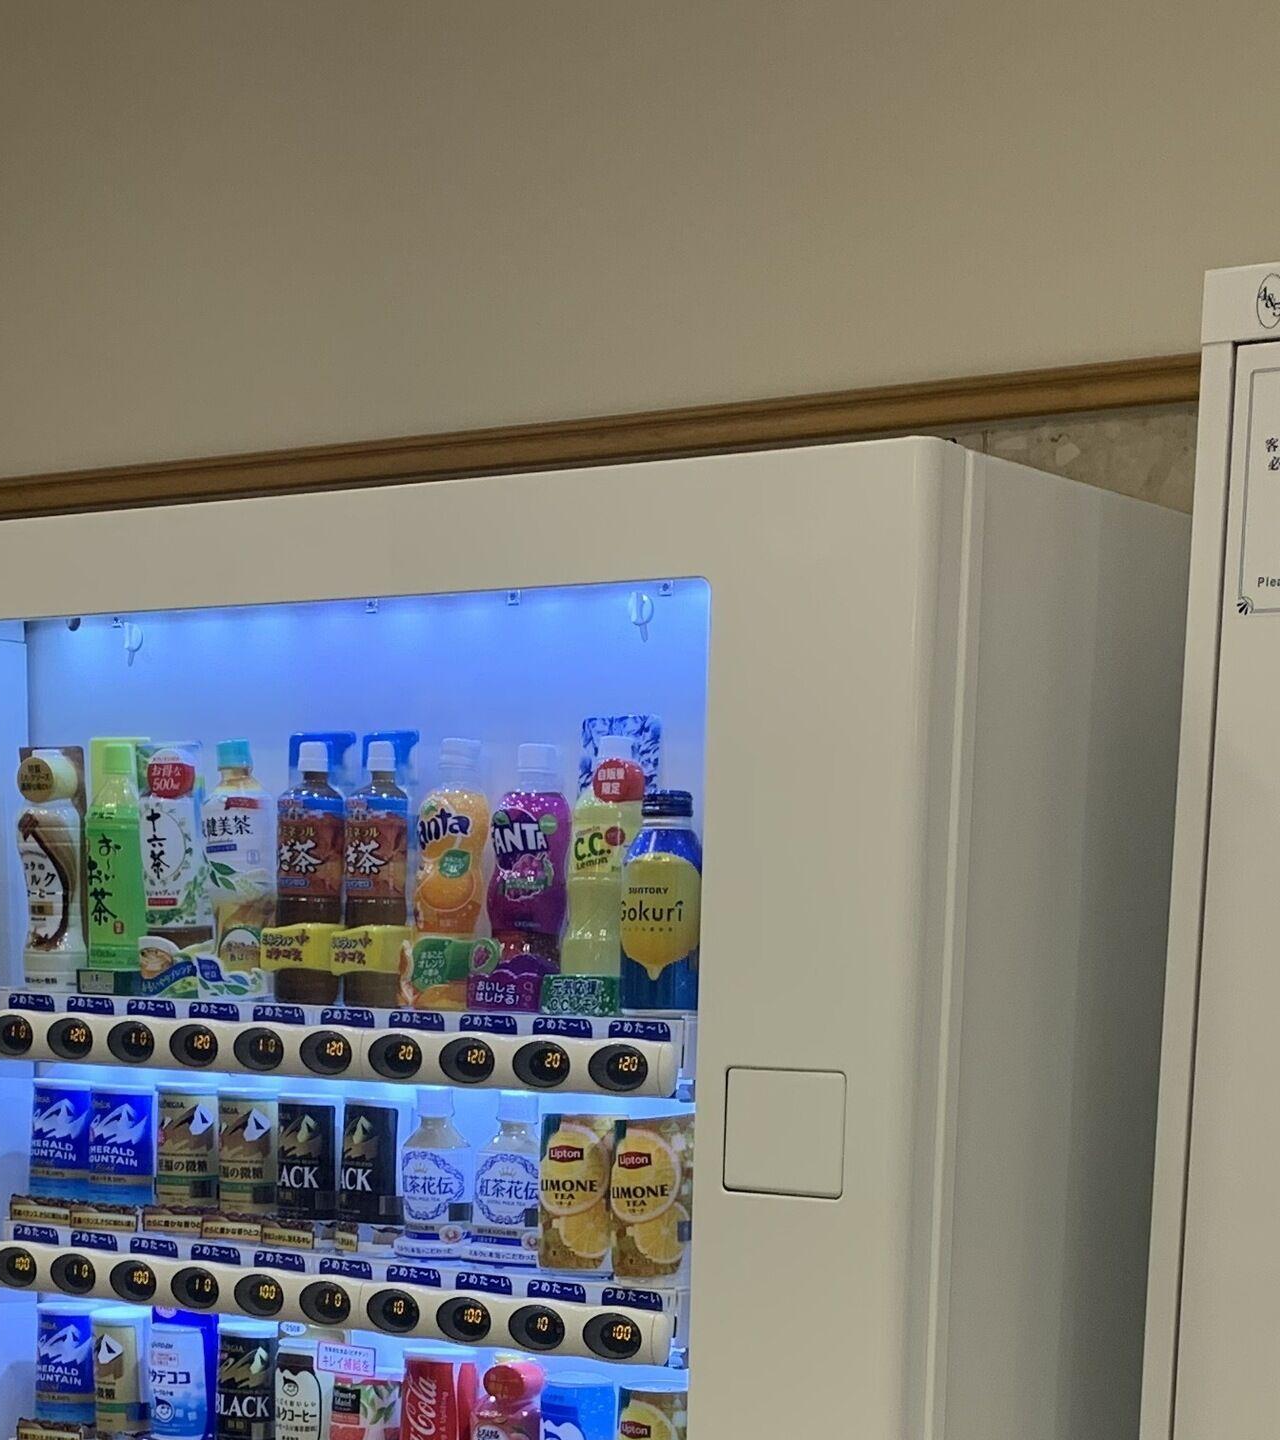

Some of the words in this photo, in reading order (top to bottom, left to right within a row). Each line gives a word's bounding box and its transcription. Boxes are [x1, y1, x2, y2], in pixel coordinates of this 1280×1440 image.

[419, 808, 470, 849] anta
[146, 808, 170, 880] 十六茶
[550, 1149, 581, 1161] Lipton
[619, 1154, 649, 1167] Lipton
[555, 1193, 575, 1201] TEA
[626, 1200, 647, 1208] TEA
[621, 1424, 648, 1435] Lipton
